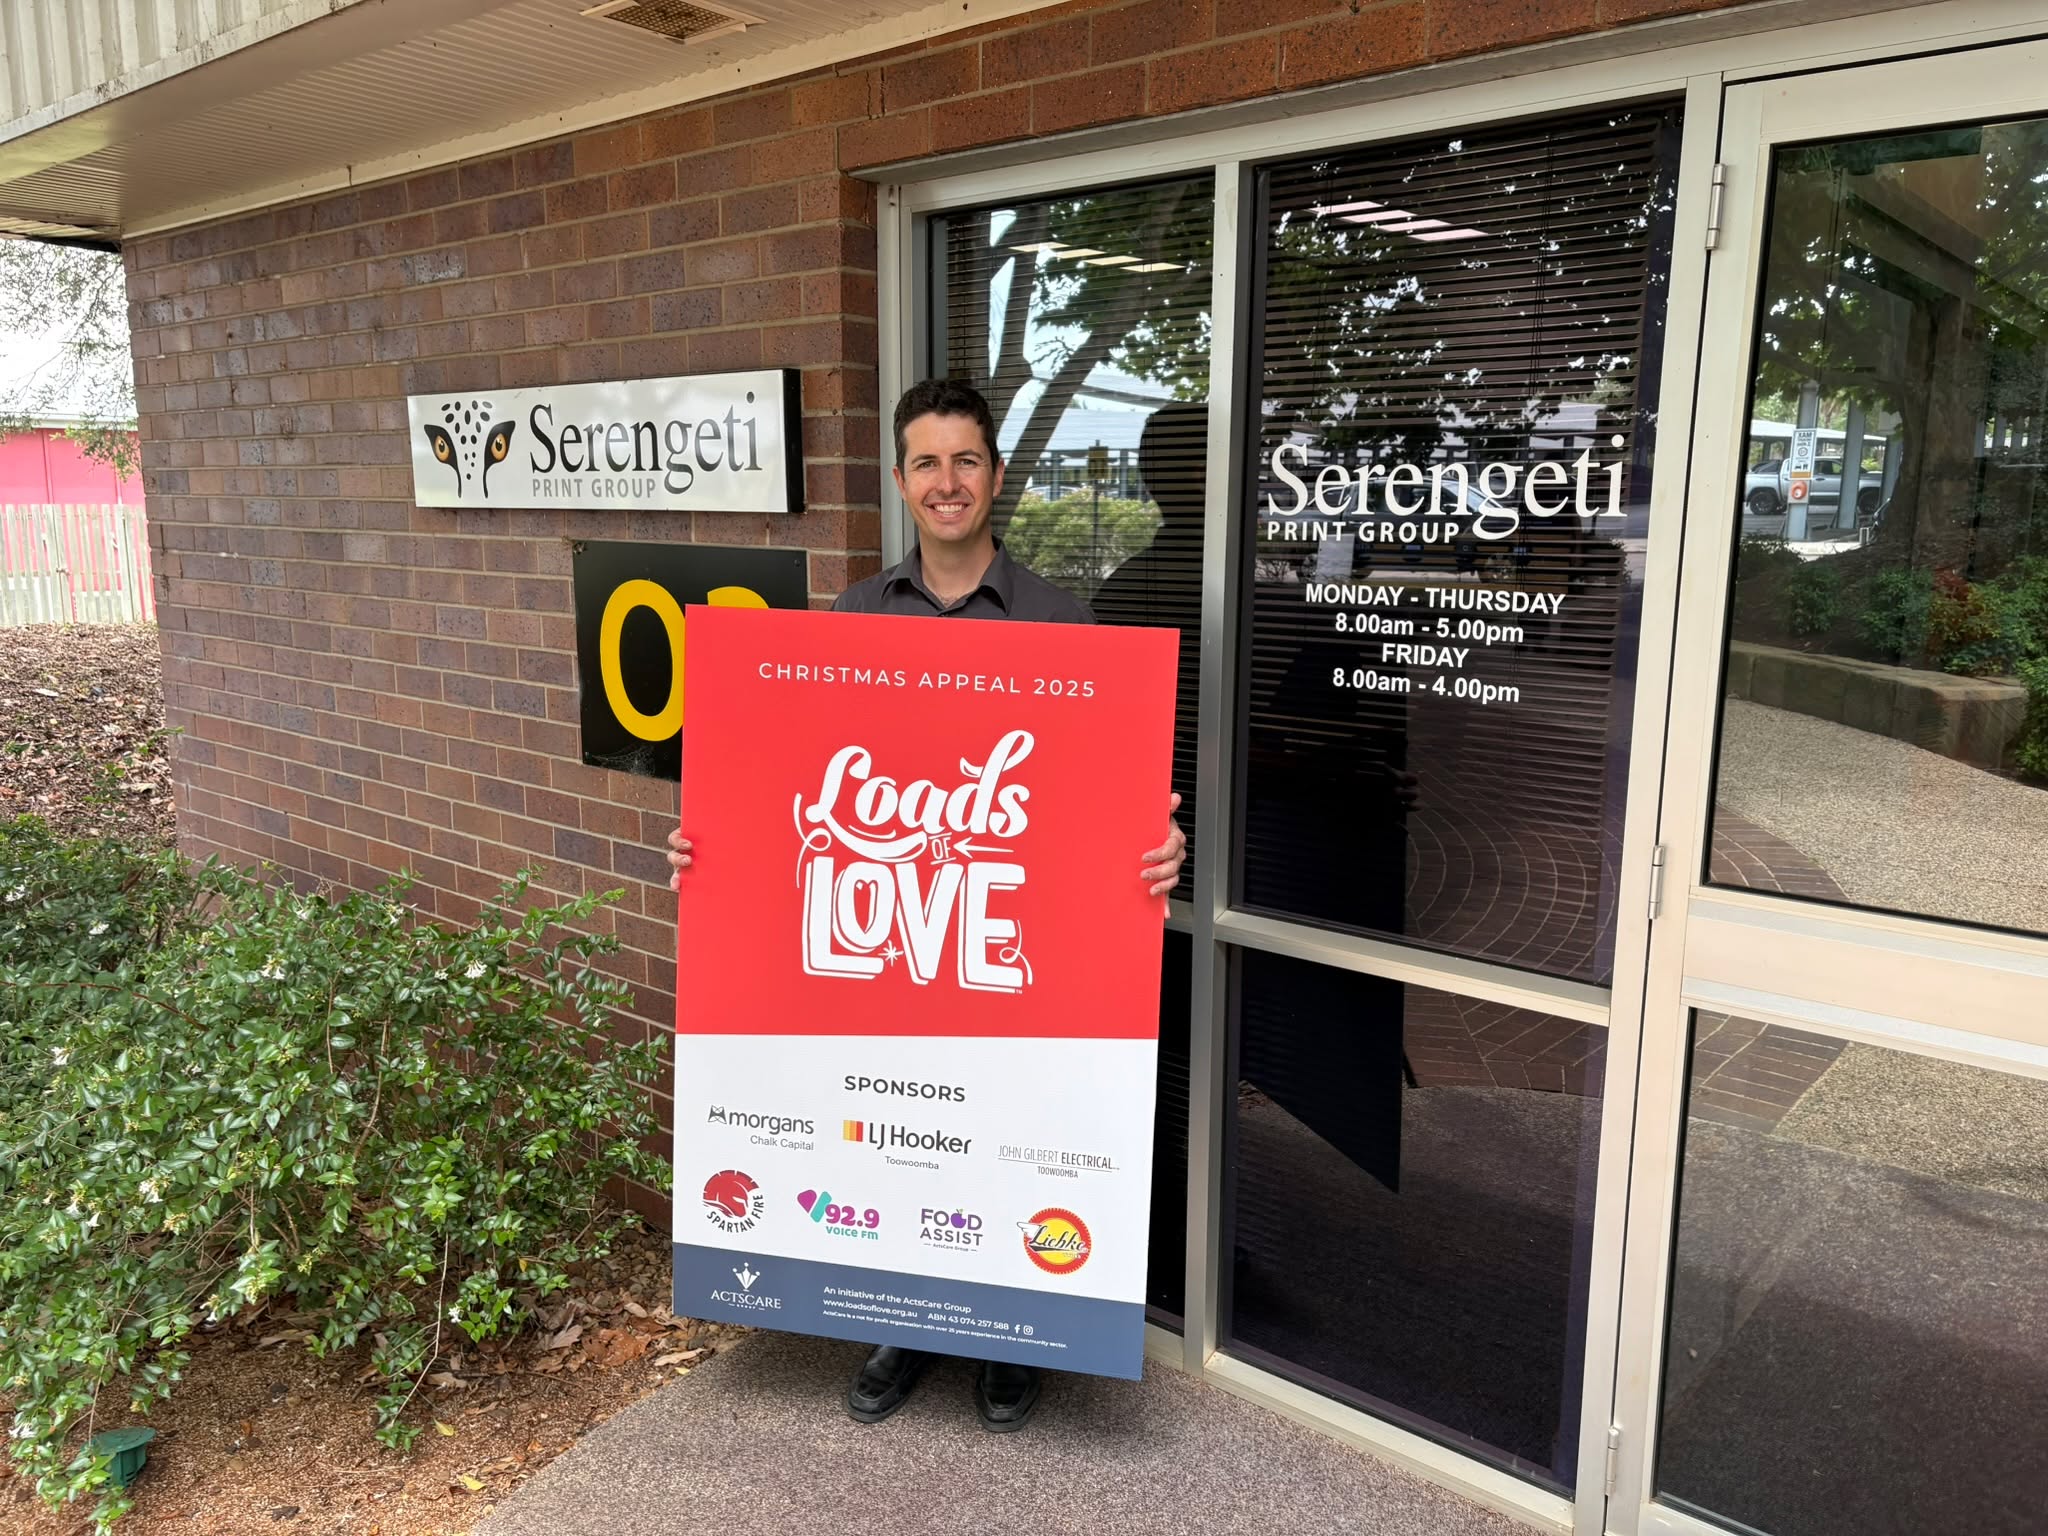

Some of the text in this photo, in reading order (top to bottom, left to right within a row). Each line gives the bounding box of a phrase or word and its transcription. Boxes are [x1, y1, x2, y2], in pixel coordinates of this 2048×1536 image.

[529, 391, 763, 495] Serengeti
[532, 477, 656, 499] PRINT GROUP
[1267, 434, 1628, 540] Serengeti
[1267, 521, 1460, 544] PRINT GROUP
[1305, 584, 1405, 607] MONDAY
[1424, 588, 1566, 615] THURSDAY
[1335, 613, 1414, 636] 8.00am
[1436, 617, 1523, 646] 5.00pm
[600, 579, 769, 742] 0
[1381, 643, 1469, 668] FRIDAY
[758, 662, 1095, 698] CHRISTMAS APPEAL 2025
[1333, 668, 1411, 692] 8.00am
[1432, 675, 1520, 704] 4.00pm
[805, 729, 1035, 862] Loads
[931, 836, 951, 860] OF
[802, 856, 1026, 994] LOVE
[844, 1075, 965, 1102] SPONSORS
[729, 1112, 814, 1135] morgans
[750, 1135, 814, 1151] Chalk Capital
[869, 1122, 972, 1154] LJ Hooker
[885, 1156, 939, 1170] Toowoomba
[999, 1145, 1113, 1169] JOHN GILBERT ELECTRICAL
[1038, 1166, 1078, 1178] TOOWOOMBA
[706, 1195, 764, 1233] SPARTAN FIRE
[825, 1204, 880, 1229] 92.9
[920, 1227, 983, 1246] ASSIST
[711, 1289, 782, 1309] ACTSCARE
[823, 1299, 917, 1318] www.loadsoflove.org.au
[824, 1286, 972, 1314] An initiative of the ActsCare Group
[927, 1313, 946, 1322] ABN
[960, 1317, 976, 1326] 074
[977, 1319, 992, 1328] 257
